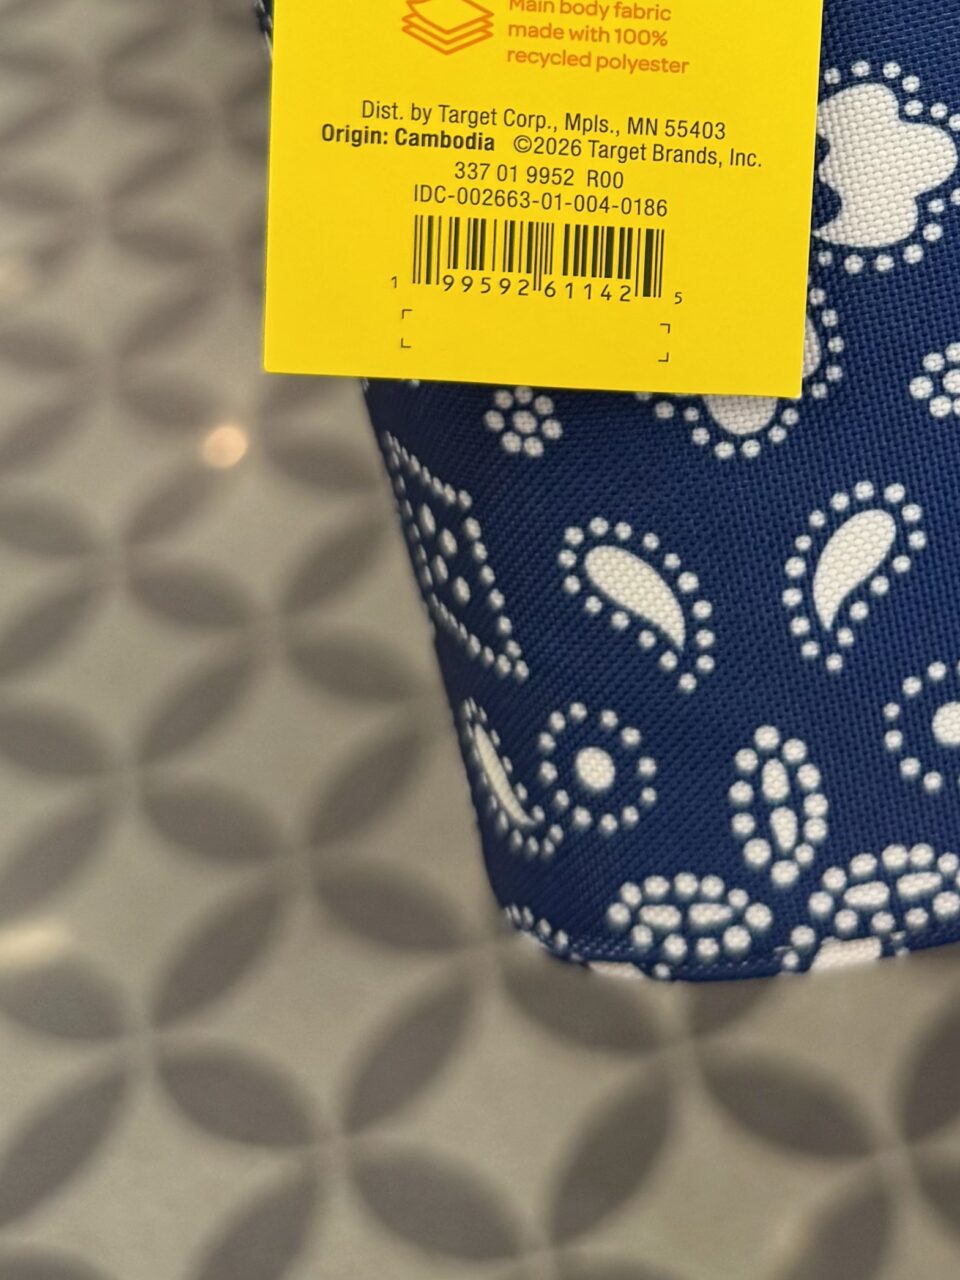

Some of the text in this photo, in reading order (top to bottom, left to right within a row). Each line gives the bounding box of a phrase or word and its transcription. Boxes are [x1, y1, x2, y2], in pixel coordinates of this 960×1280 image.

[613, 1, 672, 21] fabric
[508, 22, 668, 47] made with 100%
[507, 49, 690, 74] recycled polyester
[361, 100, 726, 139] Dist. by Target Corp., Mpls., MN 55403
[321, 124, 388, 147] Origin:
[395, 128, 495, 151] Cambodia
[588, 140, 646, 163] Target
[652, 144, 723, 168] Brands,
[730, 148, 762, 167] Inc.
[454, 162, 624, 189] 337 01 9952 R00
[414, 184, 668, 217] IDC-002663-01-004-0186
